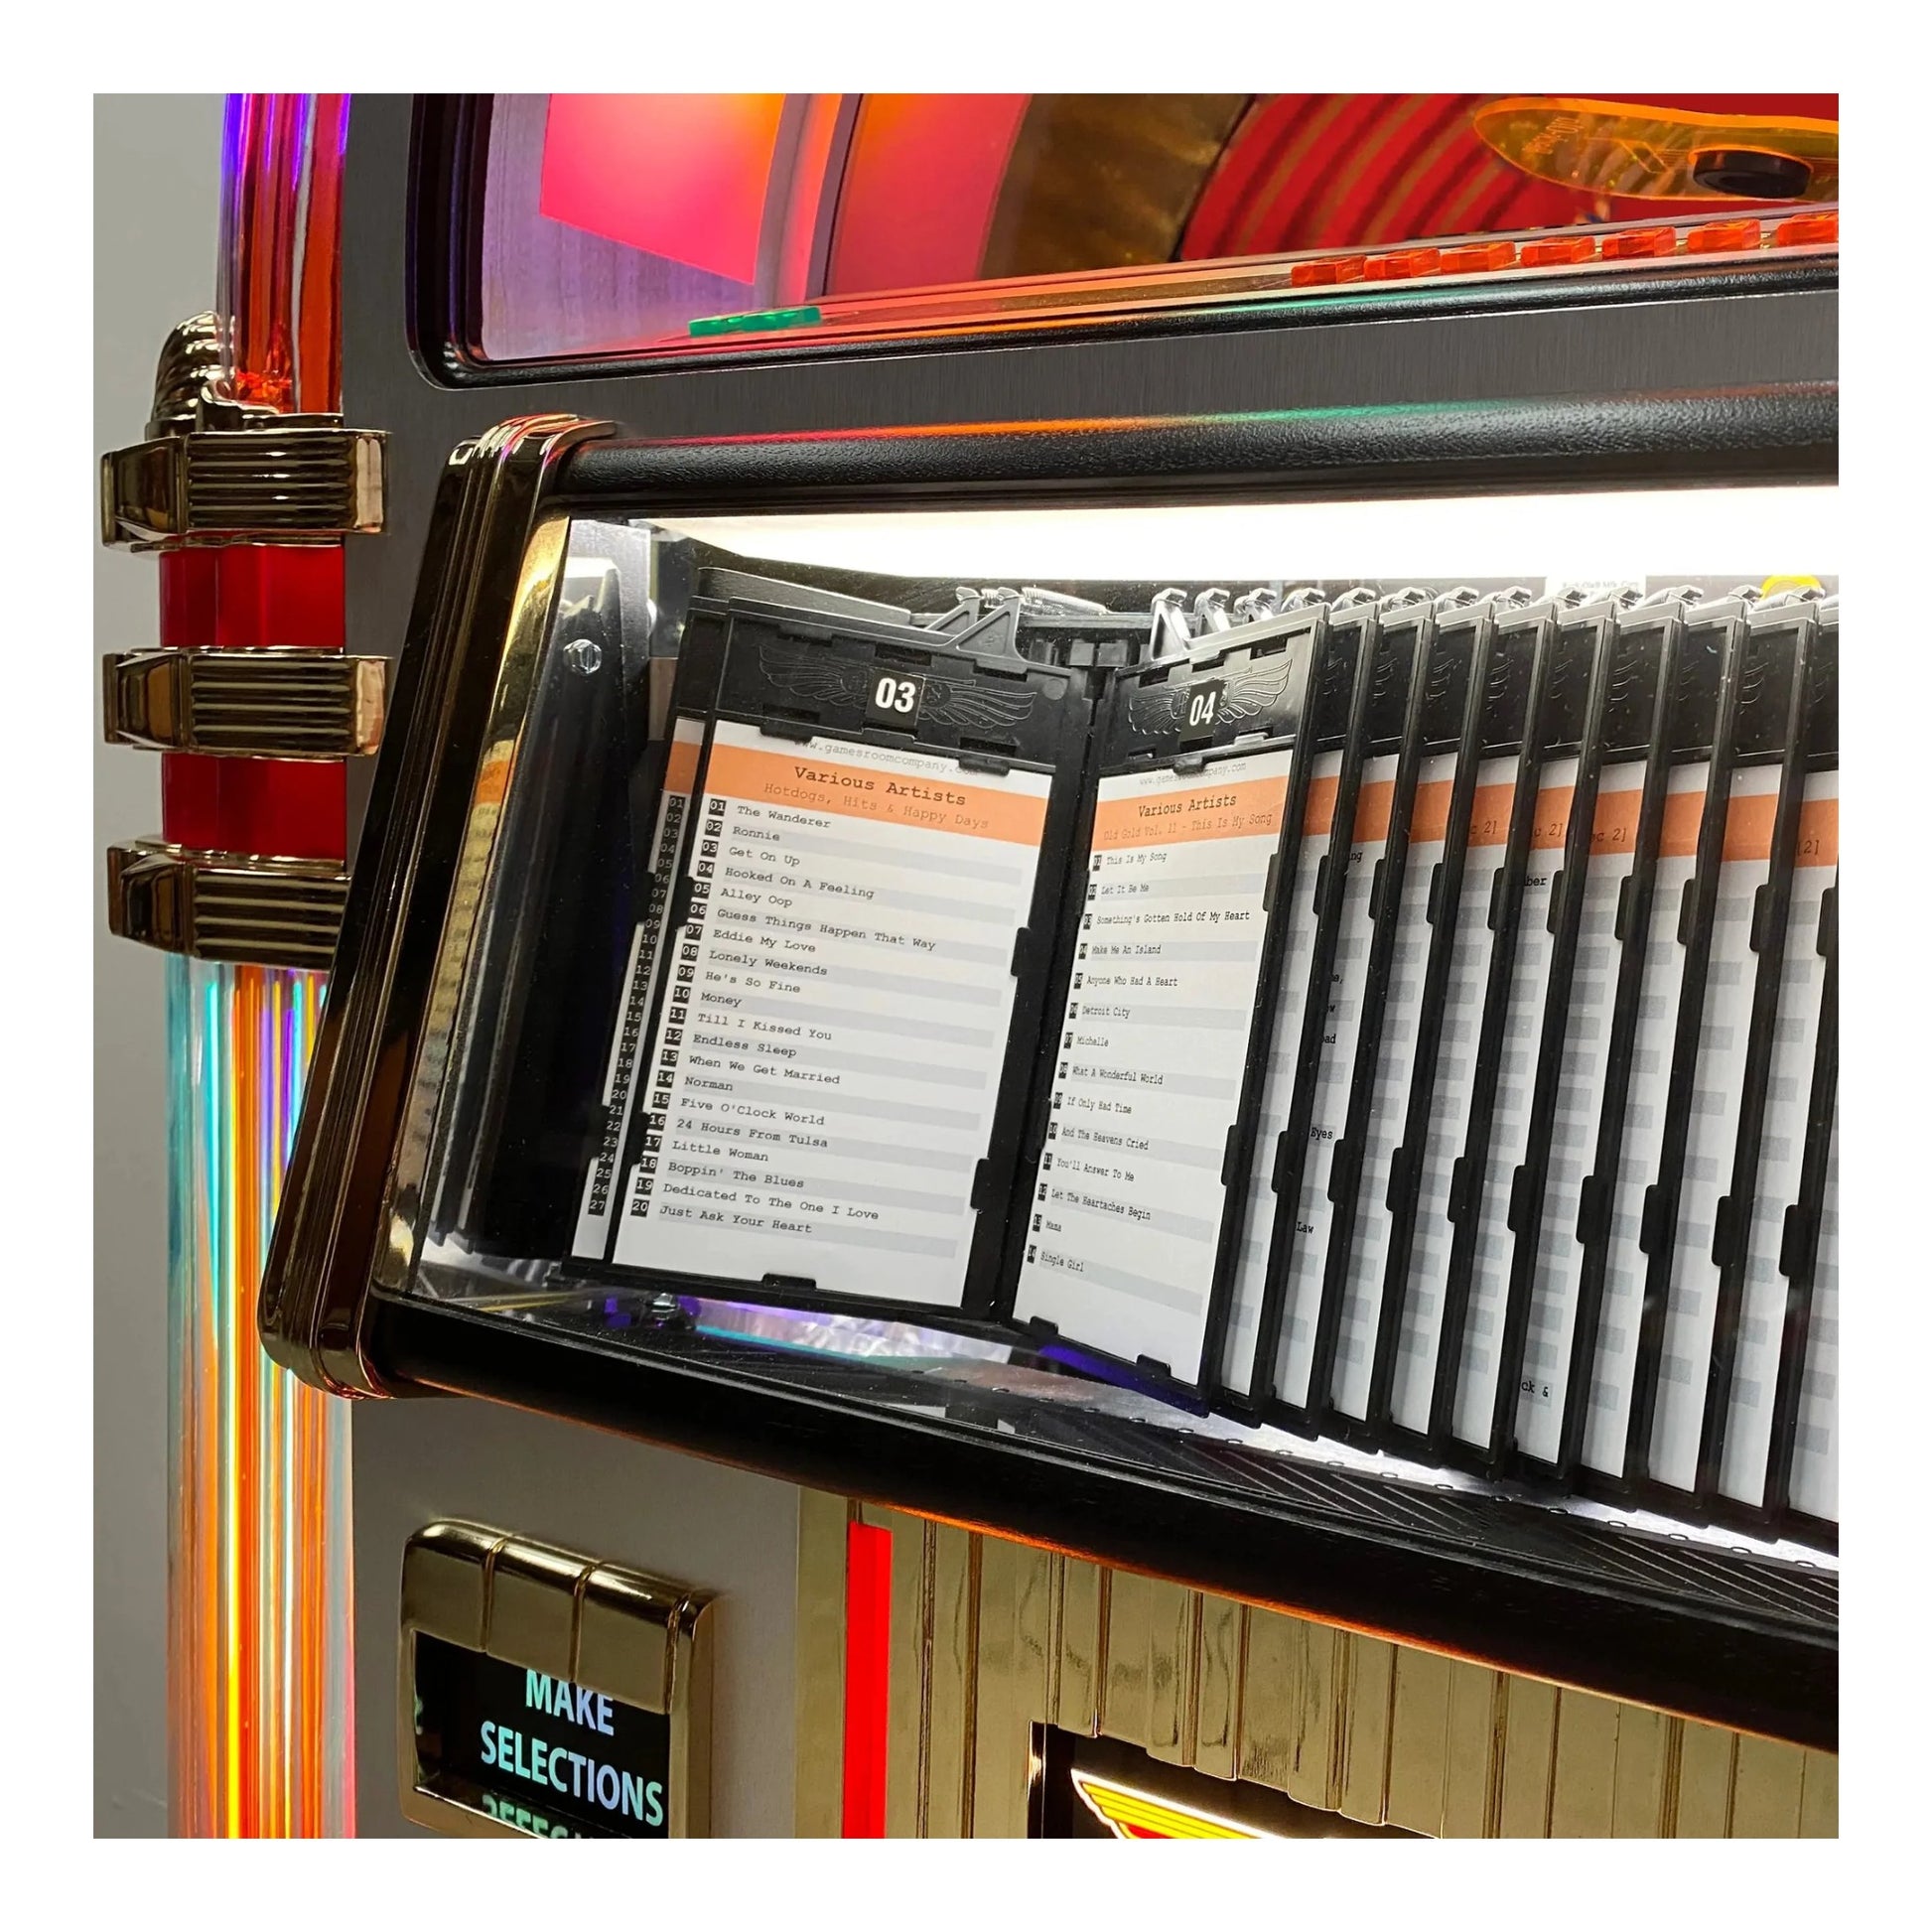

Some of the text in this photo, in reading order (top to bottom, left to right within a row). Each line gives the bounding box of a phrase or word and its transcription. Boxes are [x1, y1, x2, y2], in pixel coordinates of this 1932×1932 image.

[875, 677, 916, 713] 03
[1190, 692, 1216, 726] 04
[794, 766, 965, 804] Various Artists
[710, 801, 830, 827] 01 The Wanderer
[763, 782, 988, 829] Hotdogs, Hits & Happy Days
[1138, 794, 1236, 816] Various Artists
[706, 821, 779, 841] 02 Ronnie
[702, 842, 800, 867] 03 Get On Up
[698, 863, 874, 899] 04 Hooked On A Feeling
[694, 884, 792, 907] 05 Alley Oop
[690, 904, 935, 951] 06 Guess Things Happen That Way
[1144, 913, 1170, 922] Gotten
[1173, 911, 1192, 921] Hold
[1195, 910, 1206, 920] Of
[1208, 911, 1220, 923] My
[1224, 910, 1249, 920] Heart
[686, 925, 815, 952] 07 Eddie My Love
[682, 946, 827, 975] 08 Lonely Weekends
[632, 981, 647, 991] 13
[677, 967, 800, 993] 09 He's So Fine
[629, 996, 644, 1007] 14
[673, 988, 742, 1008] 10 Money
[626, 1012, 641, 1022] 15
[669, 1009, 831, 1039] 11 Till I Kissed You
[623, 1028, 638, 1037] 16
[665, 1030, 796, 1058] 12 Endless Sleep
[621, 1042, 635, 1053] 17
[618, 1058, 632, 1068] 18
[661, 1051, 840, 1083] 13 When We Get Married
[615, 1074, 629, 1084] 19
[657, 1072, 733, 1090] 14 Norman
[612, 1090, 626, 1100] 20
[609, 1105, 623, 1116] 21
[652, 1093, 824, 1125] 15 Five O'Clock World
[605, 1121, 621, 1131] 22
[648, 1115, 827, 1147] 16 24 Hours From Tulsa
[1311, 1127, 1333, 1140] Eyes
[602, 1137, 618, 1147] 23
[644, 1136, 767, 1161] 17 Little Woman
[599, 1153, 615, 1163] 24
[596, 1169, 612, 1178] 25
[640, 1158, 803, 1187] 18 Boppin' The Blues
[593, 1184, 608, 1194] 26
[635, 1179, 879, 1219] 19 Dedicated To The One I Love
[589, 1200, 605, 1210] 27
[631, 1200, 811, 1232] 20 Just Ask Your Heart
[1297, 1221, 1314, 1234] Law
[526, 1668, 614, 1736] MAKE
[480, 1720, 663, 1827] SELECTIONS
